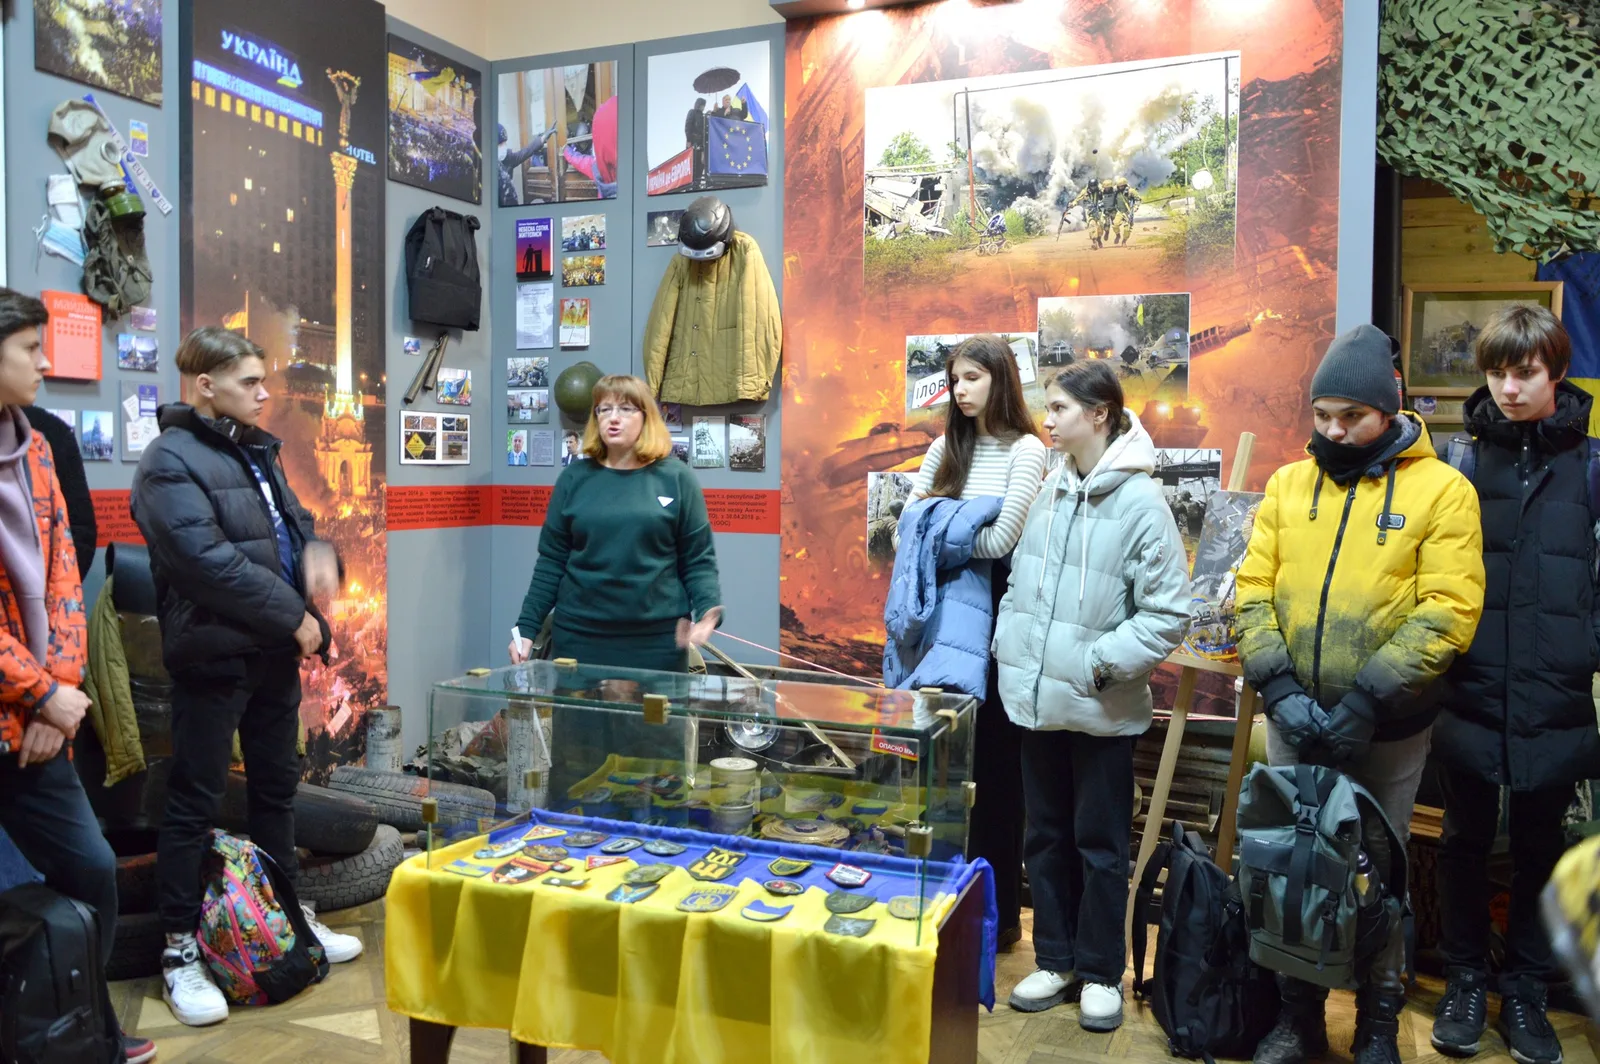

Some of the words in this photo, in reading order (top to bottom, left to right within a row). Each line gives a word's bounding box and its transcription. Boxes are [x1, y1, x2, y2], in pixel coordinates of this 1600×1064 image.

[221, 30, 304, 87] УКРАЇНА
[915, 377, 947, 400] ІЛОВ
[878, 742, 904, 753] ОПАСНО
